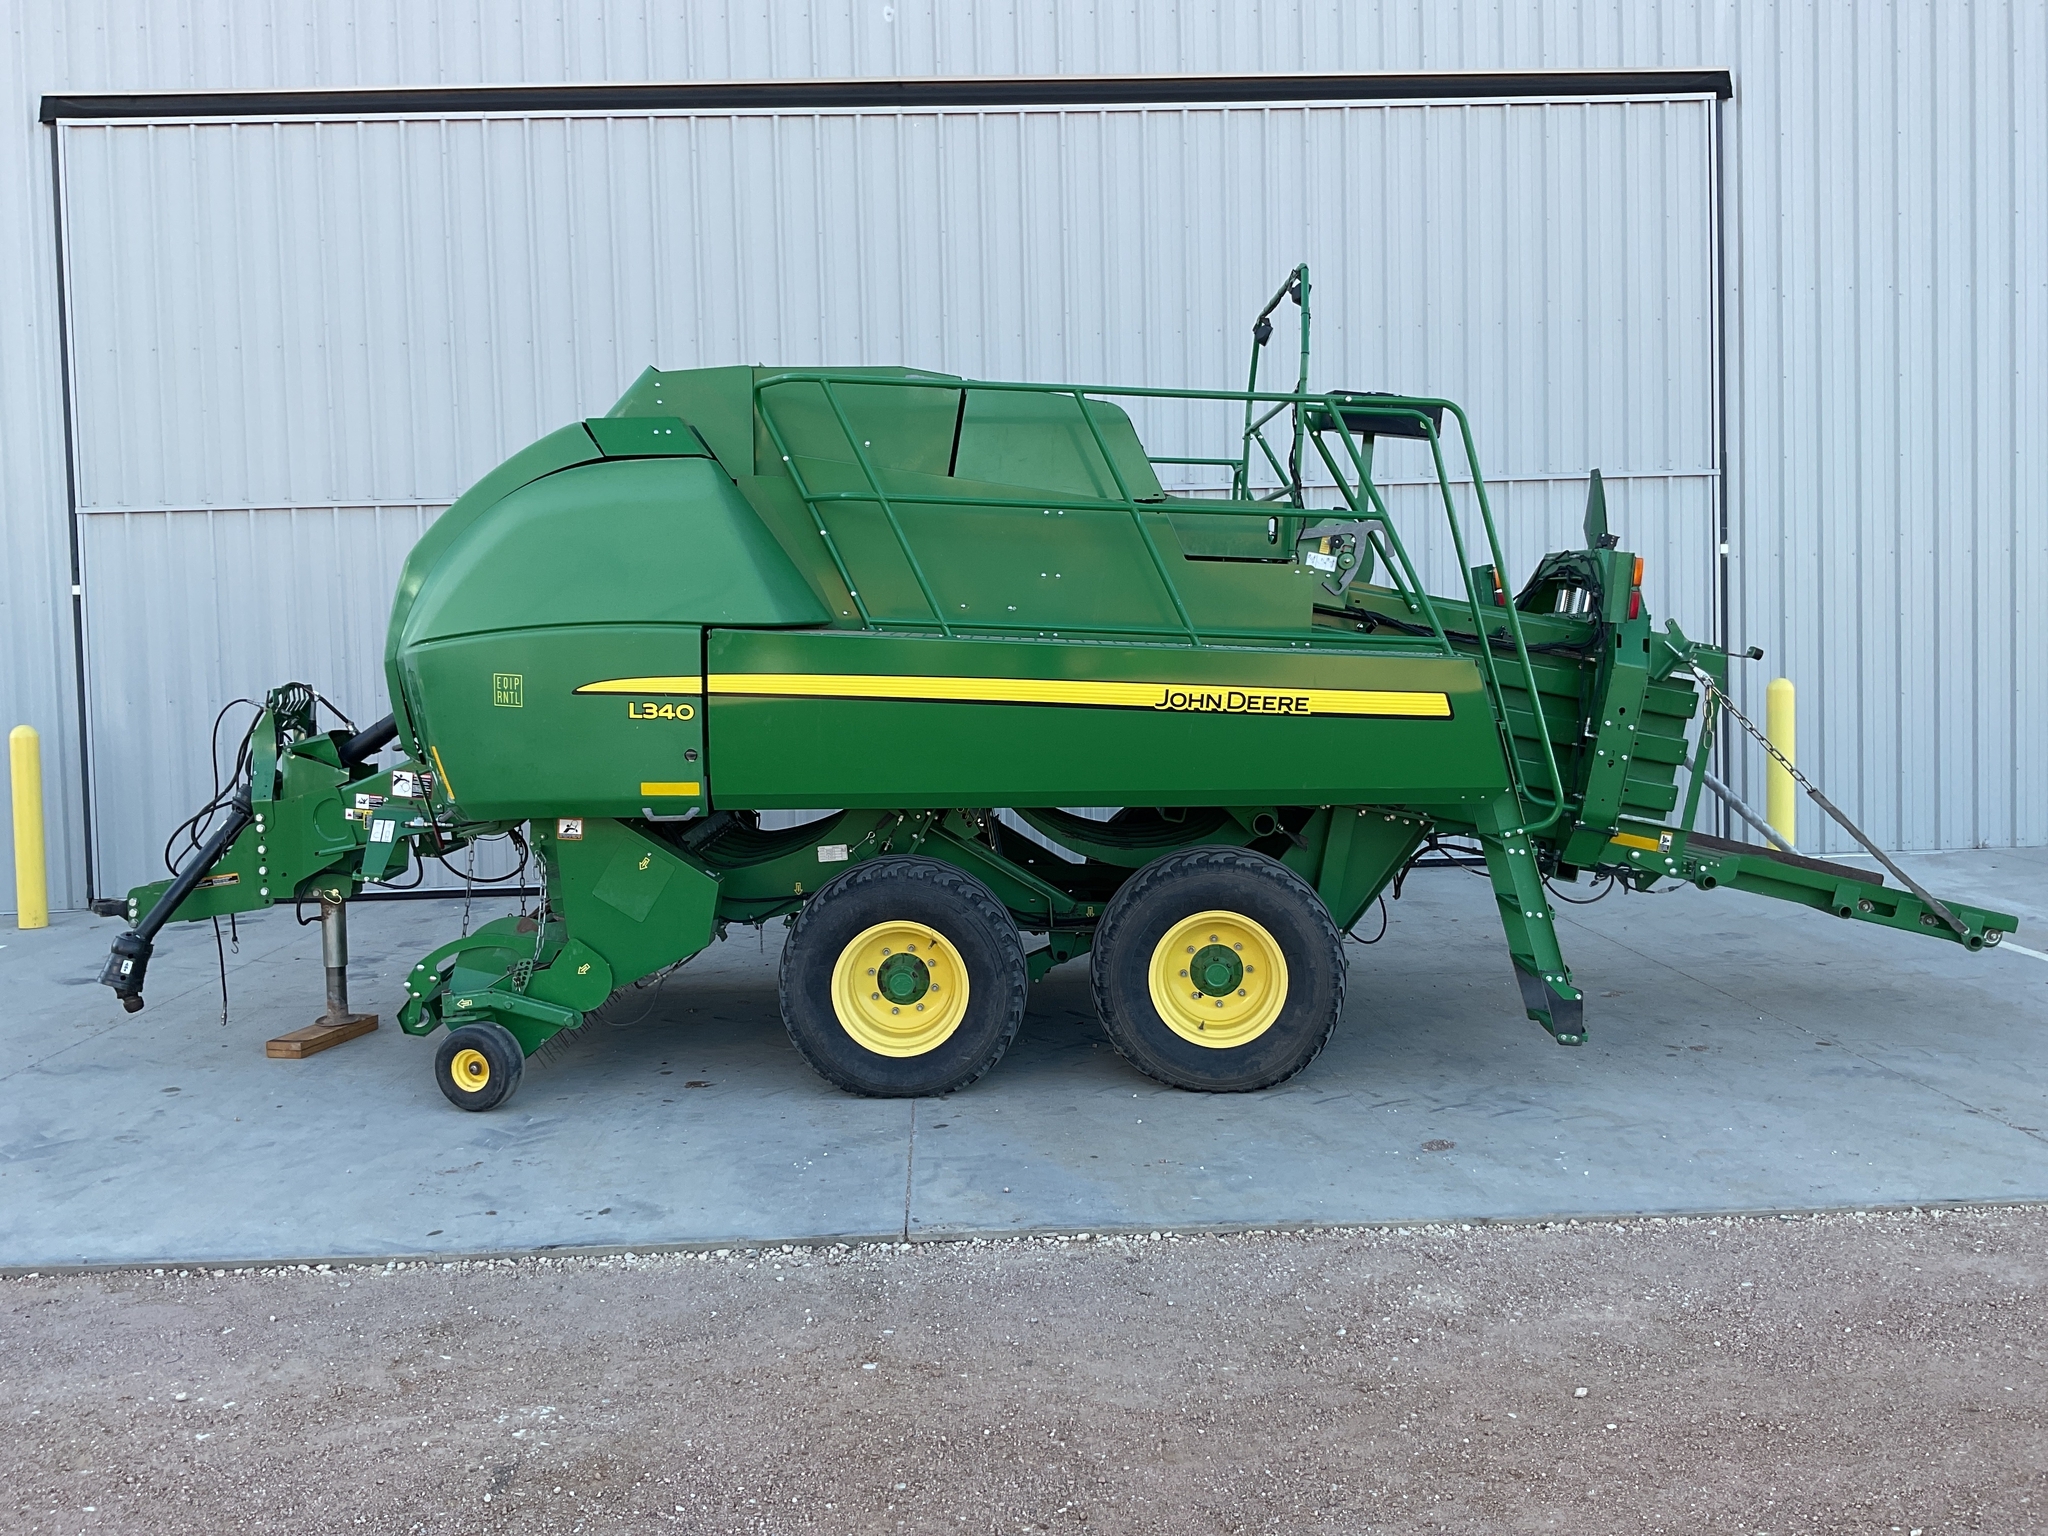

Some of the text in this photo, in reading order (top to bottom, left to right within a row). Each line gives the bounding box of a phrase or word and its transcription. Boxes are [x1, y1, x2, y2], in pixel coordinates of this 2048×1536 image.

[496, 690, 520, 705] RNTL
[1154, 688, 1310, 712] JOHN DEERE
[628, 701, 696, 721] L340
